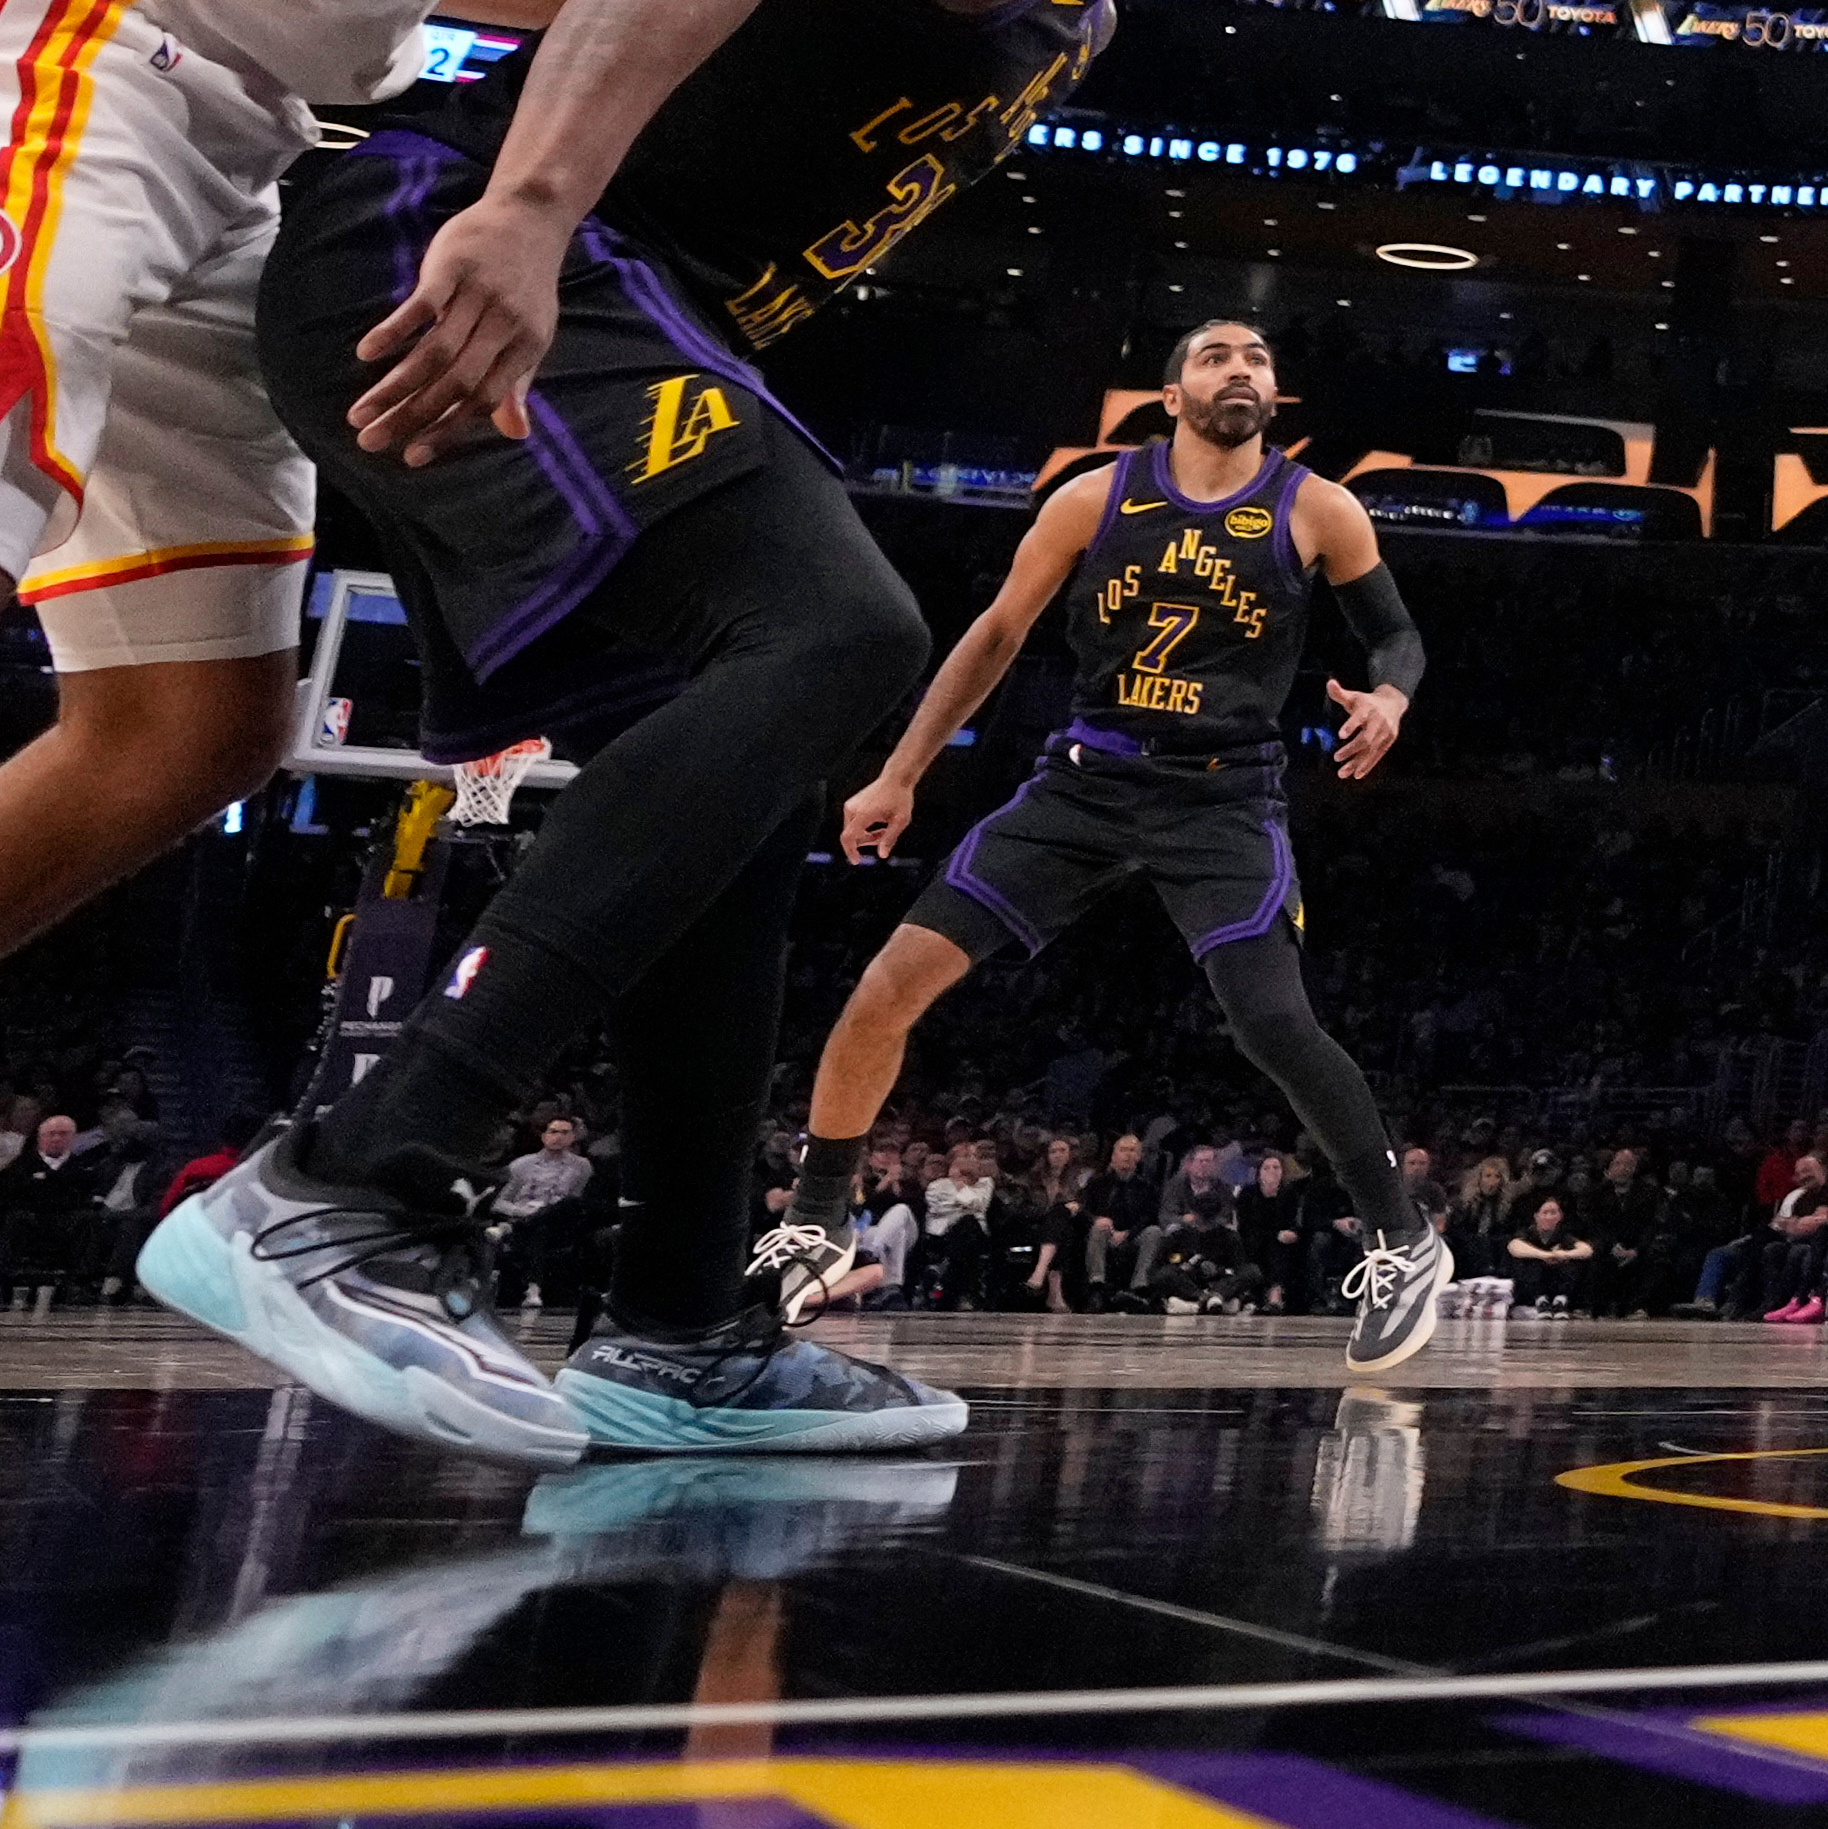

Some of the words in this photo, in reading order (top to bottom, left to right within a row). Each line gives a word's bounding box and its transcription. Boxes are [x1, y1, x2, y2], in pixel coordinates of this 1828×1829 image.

[1547, 5, 1617, 26] TOYOTA
[1741, 11, 1791, 48] 50
[427, 48, 449, 76] 2
[1122, 134, 1247, 165] SINCE
[1266, 146, 1358, 174] 1976
[1429, 160, 1655, 199] LEGENDARY
[1098, 565, 1142, 624] LOS
[1158, 528, 1268, 639] ANGELES
[1132, 602, 1200, 674] 7
[1117, 673, 1204, 715] LAKERS
